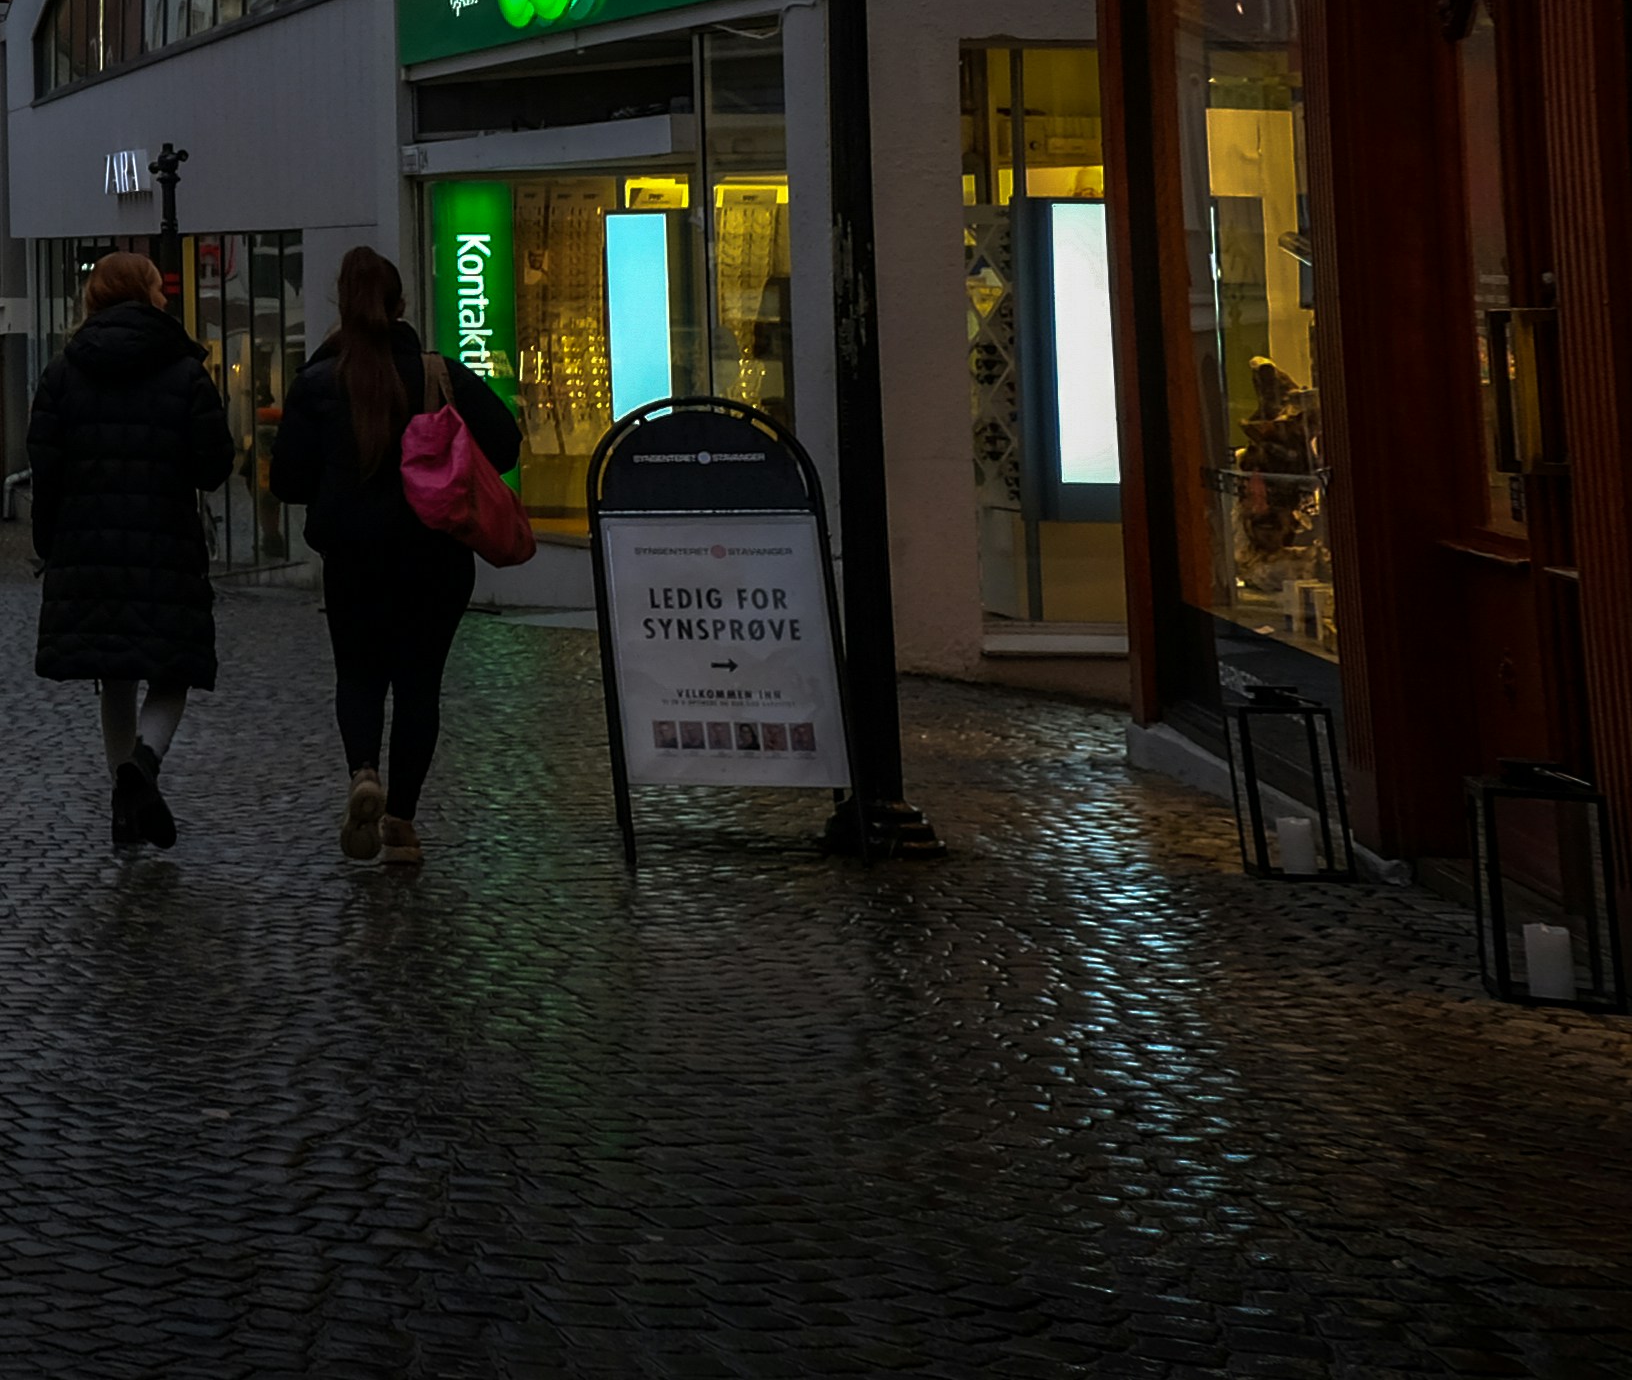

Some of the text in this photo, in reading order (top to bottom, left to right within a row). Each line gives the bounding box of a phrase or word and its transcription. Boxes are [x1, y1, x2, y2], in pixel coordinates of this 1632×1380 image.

[455, 233, 495, 382] Kontaktli
[649, 587, 788, 610] LEDIG FOR
[643, 617, 802, 641] SYNSPRØVE
